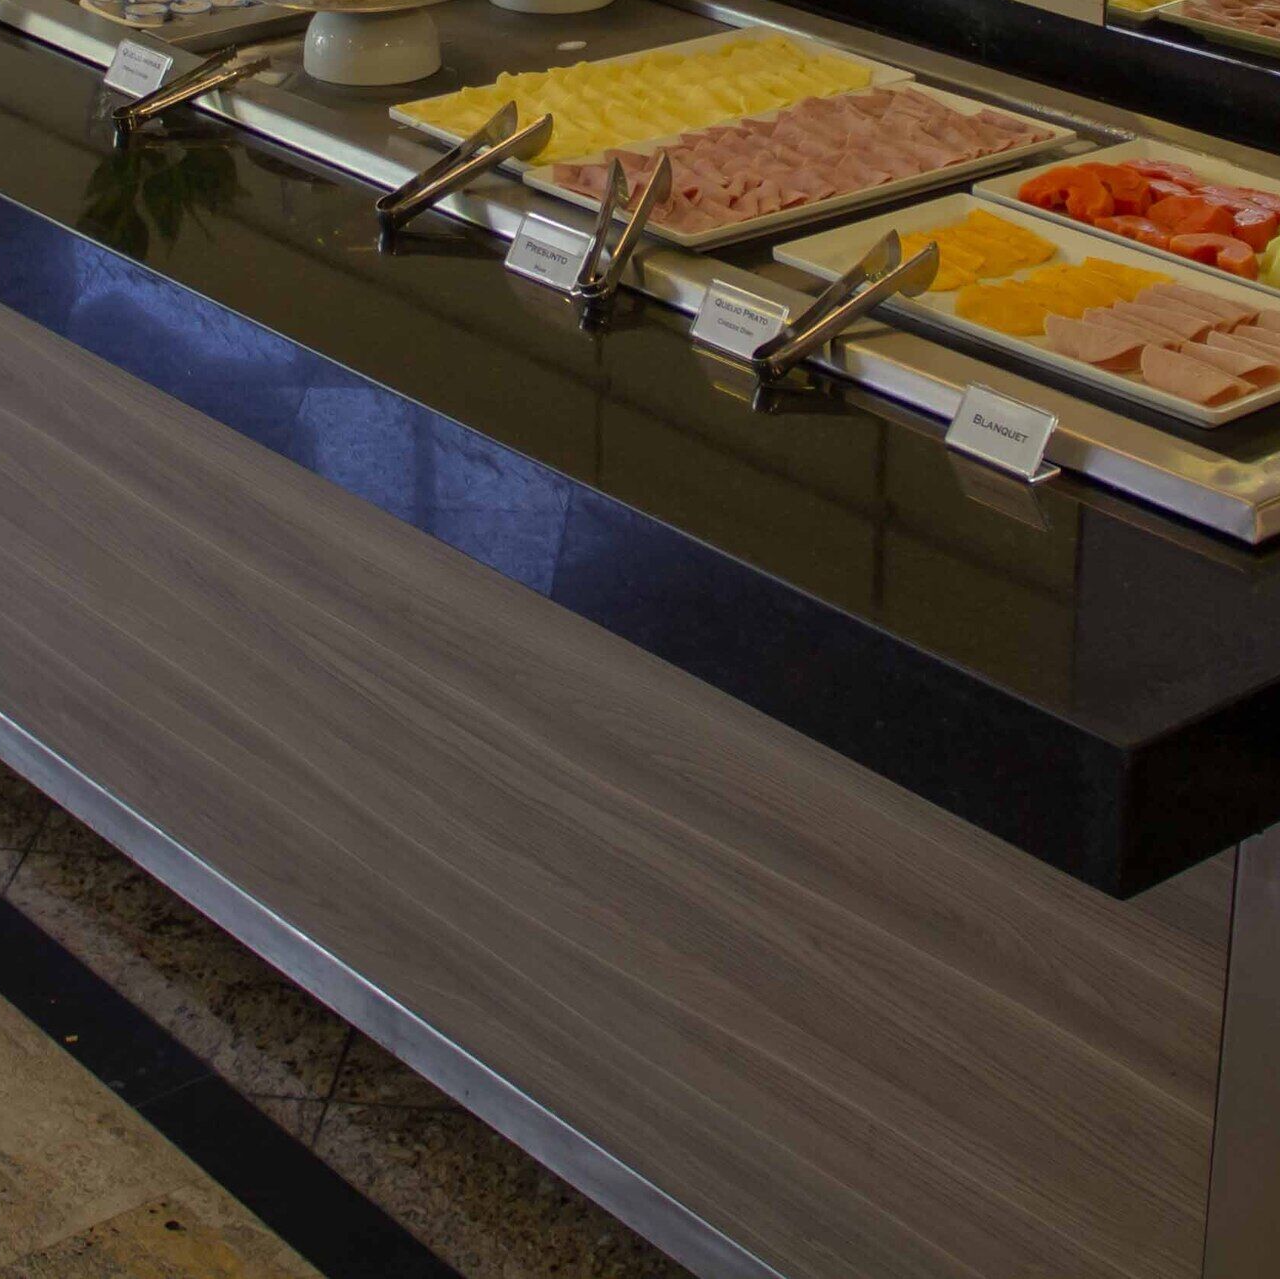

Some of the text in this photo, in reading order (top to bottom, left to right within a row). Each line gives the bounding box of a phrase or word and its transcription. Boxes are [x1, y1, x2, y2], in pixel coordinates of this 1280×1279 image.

[525, 241, 569, 265] PRESUNTO
[742, 308, 769, 326] PRATO
[972, 413, 1030, 444] BLANQUET
